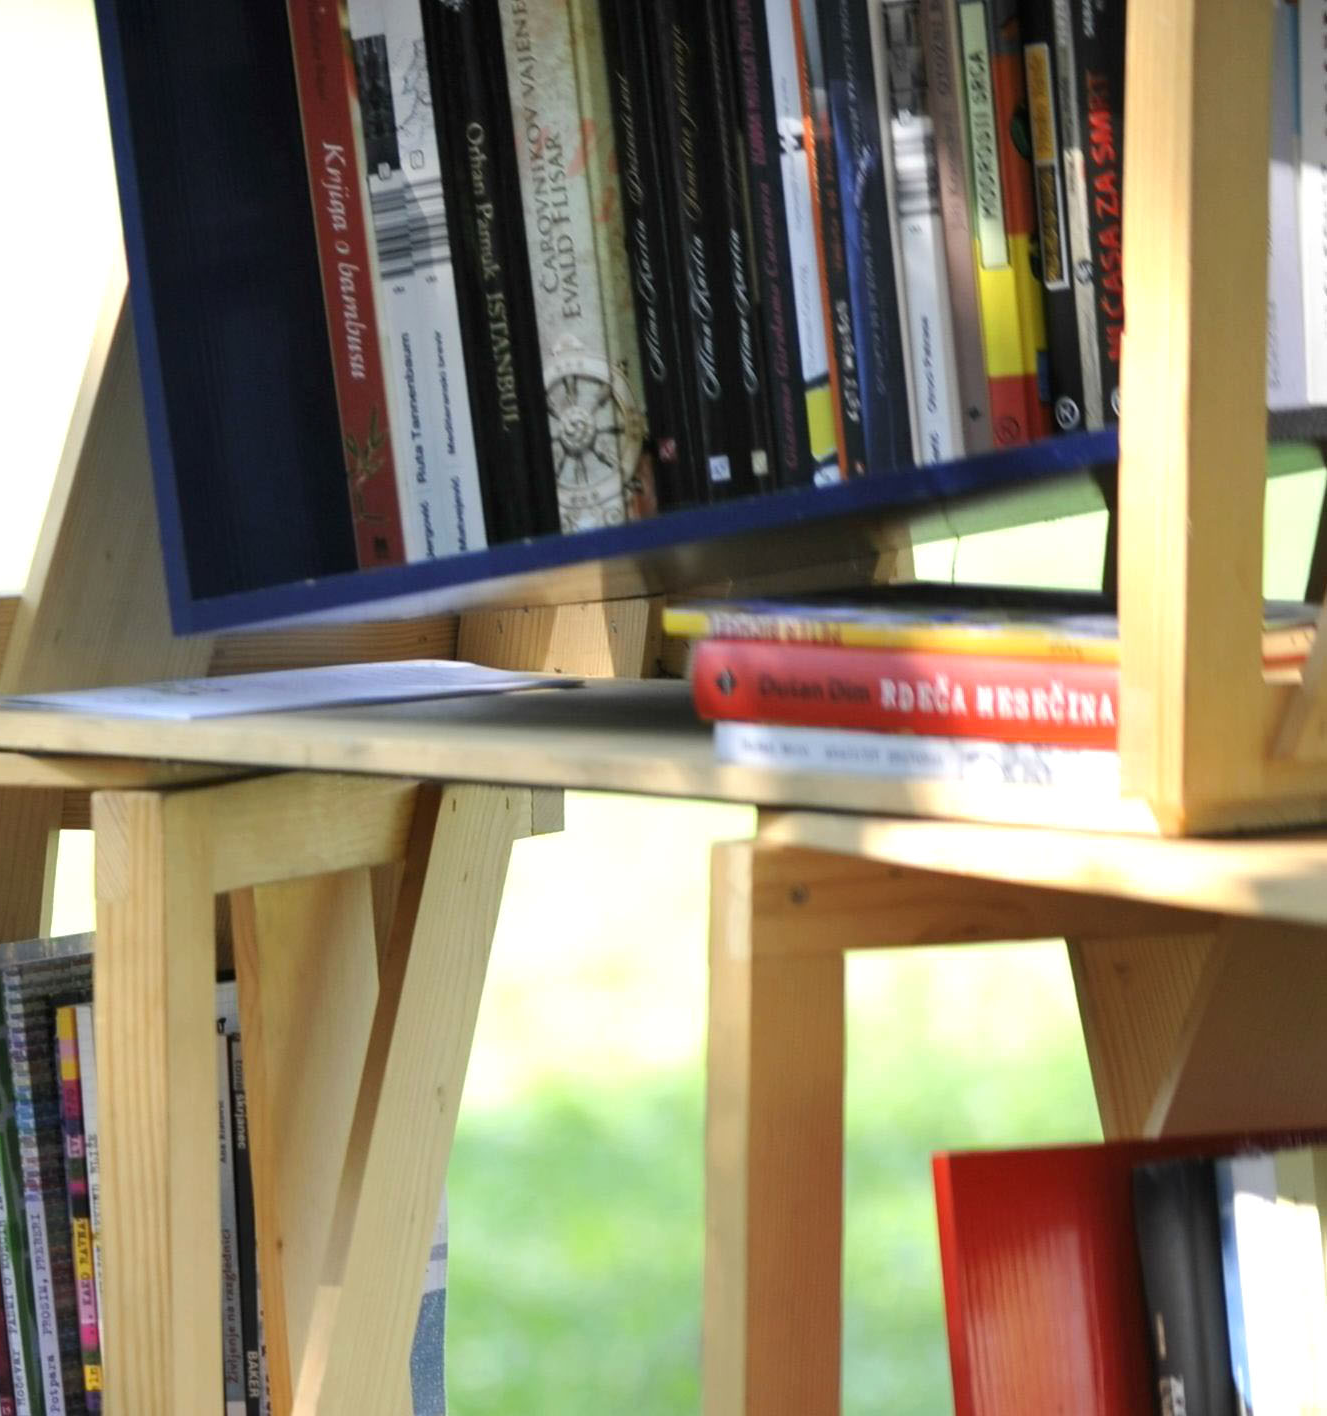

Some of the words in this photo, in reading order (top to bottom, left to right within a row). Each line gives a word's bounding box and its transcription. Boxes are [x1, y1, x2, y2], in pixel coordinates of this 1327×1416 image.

[316, 138, 353, 232] Knjiga
[464, 121, 490, 196] Orhan
[541, 131, 572, 226] FLISAR
[1091, 168, 1120, 218] ZA
[473, 203, 500, 281] Pamuk
[553, 232, 583, 319] EVALD
[723, 227, 751, 315] Karlin
[334, 260, 371, 382] bambusu
[733, 318, 761, 395] Alma
[398, 331, 422, 439] Tannenbaum
[484, 289, 520, 433] ISTANBUL
[411, 444, 427, 484] Ruta
[28, 1212, 48, 1271] PREBERI
[43, 1353, 62, 1413] Potpara
[242, 1348, 263, 1399] BAKER
